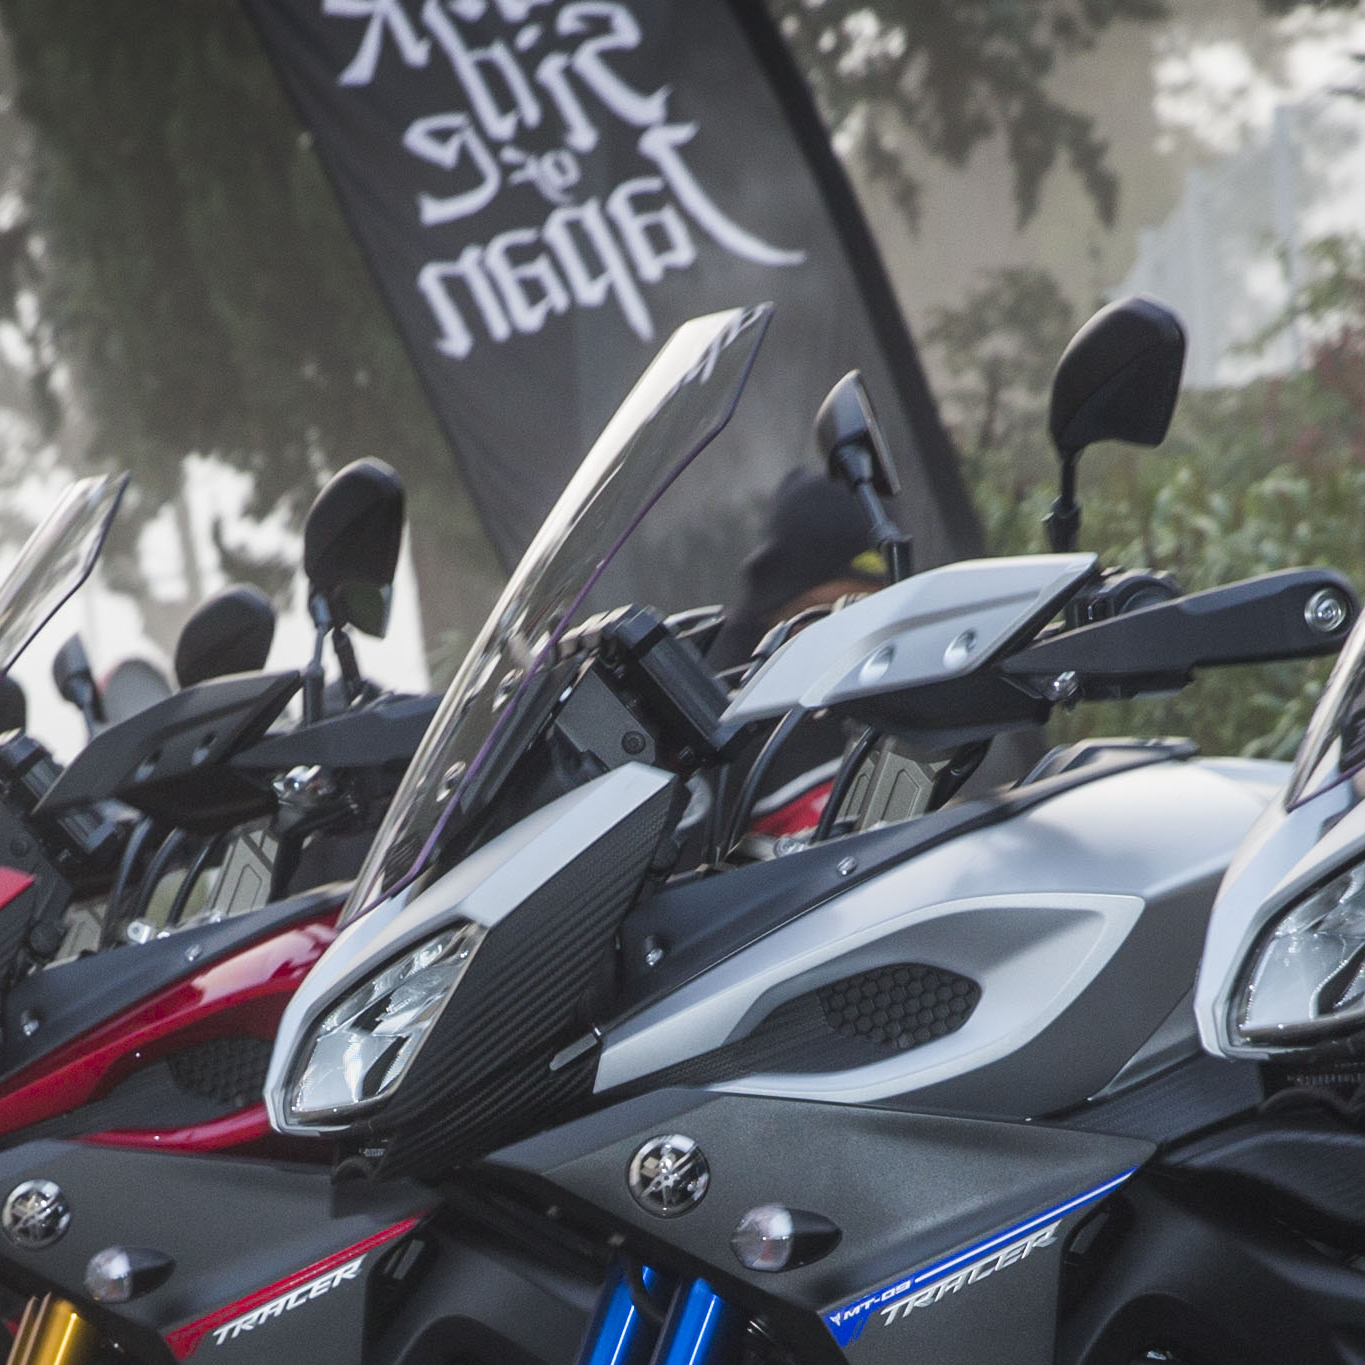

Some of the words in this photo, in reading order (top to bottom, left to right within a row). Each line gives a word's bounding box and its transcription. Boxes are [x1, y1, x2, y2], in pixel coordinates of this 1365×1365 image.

[212, 1253, 368, 1346] TRACER
[842, 1279, 912, 1322] MT-09
[880, 1219, 1063, 1326] TRACER
